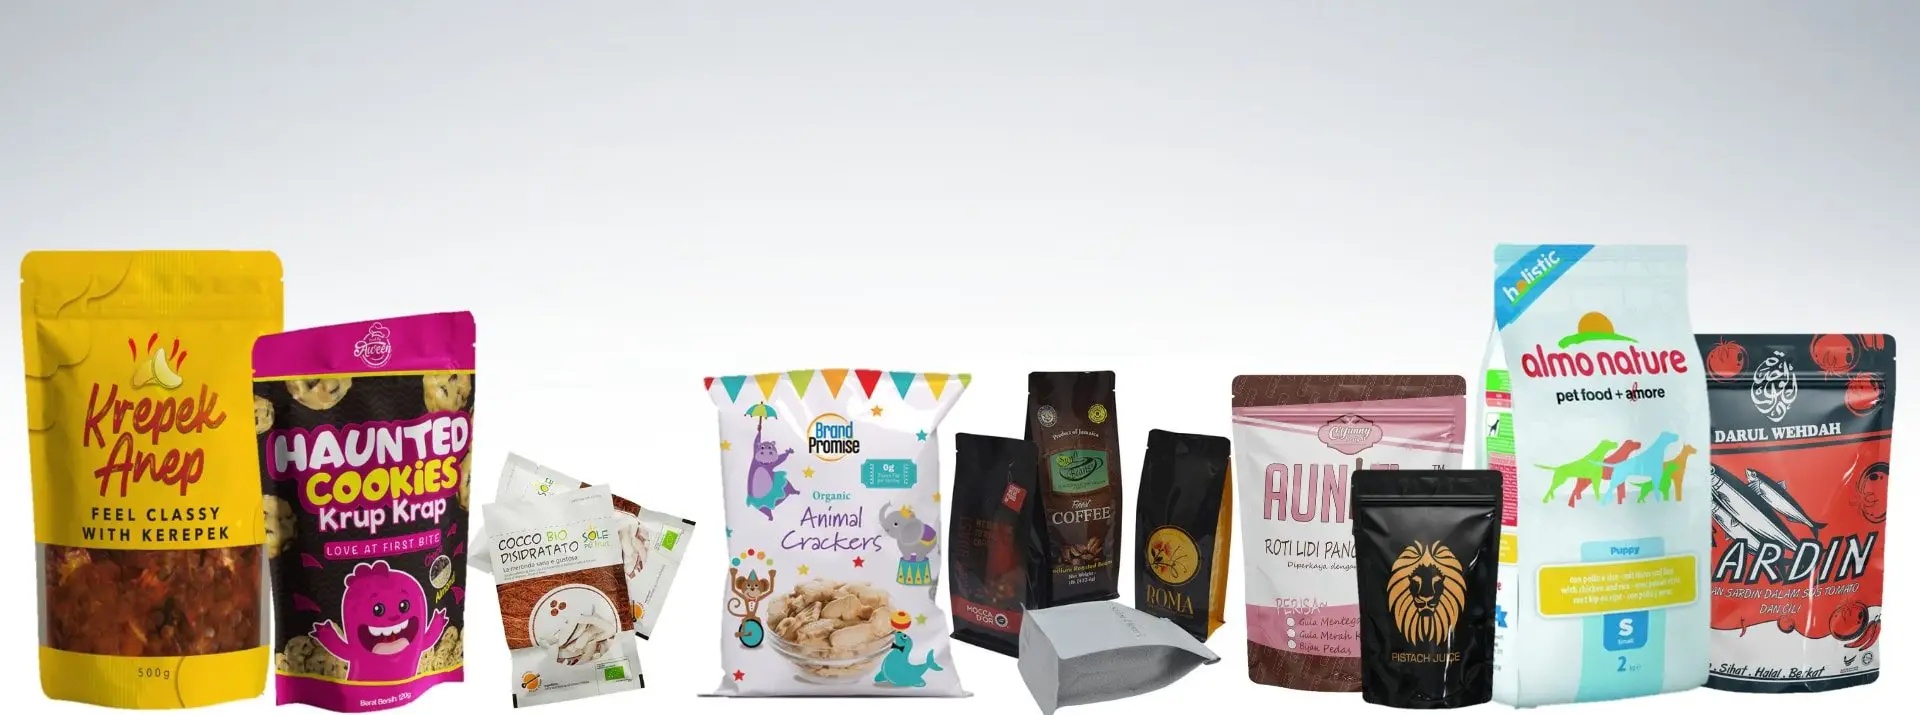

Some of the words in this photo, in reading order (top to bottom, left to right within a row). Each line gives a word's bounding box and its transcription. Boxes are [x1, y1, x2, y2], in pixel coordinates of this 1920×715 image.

[1502, 250, 1560, 303] holistic
[1522, 344, 1594, 379] almo
[1597, 345, 1688, 375] nature
[1556, 389, 1580, 404] pet
[1581, 387, 1613, 401] food
[83, 382, 226, 447] Krepek
[816, 422, 853, 438] Brand
[1714, 427, 1768, 443] DARUL
[1773, 422, 1841, 440] WEHDAH
[274, 416, 468, 474] HAUNTED
[808, 438, 860, 455] Promise
[93, 431, 205, 497] Anep
[813, 490, 851, 502] Organic
[92, 507, 135, 522] FEEL
[146, 507, 221, 522] CLASSY
[319, 507, 385, 534] Krup
[392, 497, 446, 523] Krap
[800, 507, 863, 528] Animal
[1052, 507, 1111, 525] COFFEE
[82, 527, 130, 542] WITH
[142, 525, 230, 542] KEREPEK
[498, 533, 542, 551] COCCO
[546, 529, 568, 542] BIO
[582, 529, 609, 543] SOLE
[781, 530, 883, 552] Crackers
[326, 543, 358, 557] LOVE
[364, 542, 379, 554] AT
[383, 537, 415, 552] FIRST
[418, 533, 440, 547] BITE
[500, 541, 579, 564] DISIDRATATO
[1265, 538, 1292, 556] ROTI
[1297, 541, 1320, 557] LIDI
[1610, 546, 1640, 556] Puppy
[1287, 561, 1328, 571] Diperkaya
[1712, 531, 1879, 586] ARDIN
[1147, 584, 1194, 614] ROMA
[1725, 588, 1761, 599] SARDIN
[1764, 588, 1799, 599] DALAM
[1824, 583, 1860, 596] TOMATO
[966, 605, 993, 618] MOCCA
[1276, 596, 1328, 616] PERISAN
[1760, 604, 1780, 614] DAN
[1299, 618, 1318, 626] Gula
[1618, 618, 1633, 636] S
[1299, 630, 1318, 640] Gula
[1321, 631, 1352, 640] Merah
[1323, 644, 1352, 655] Pedas
[1391, 652, 1431, 663] PISTACH
[1617, 656, 1627, 672] 2
[1719, 663, 1747, 676] Sihat
[1755, 666, 1781, 678] Halal
[138, 667, 170, 680] 500g
